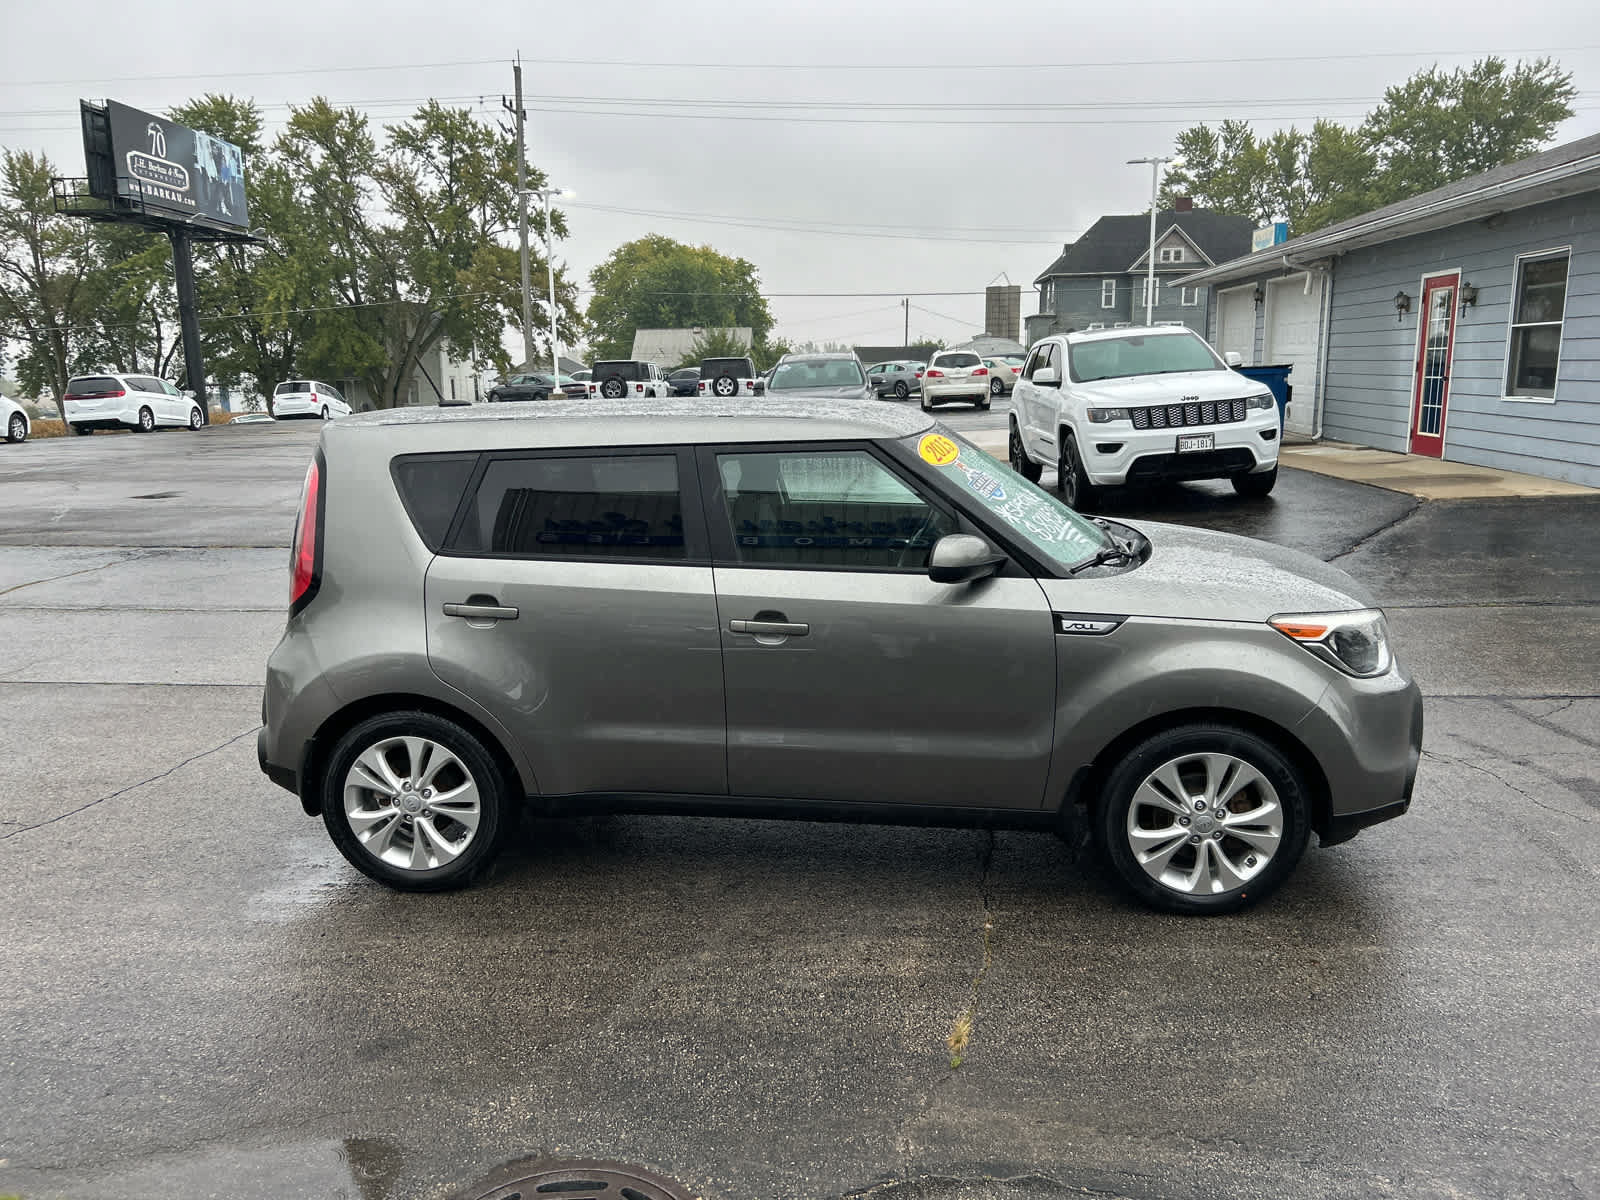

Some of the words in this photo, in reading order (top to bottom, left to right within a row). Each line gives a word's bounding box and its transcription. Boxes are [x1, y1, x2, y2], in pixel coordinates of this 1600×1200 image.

[148, 130, 166, 158] 70
[925, 436, 956, 463] 2015
[1064, 623, 1101, 631] SOUL
